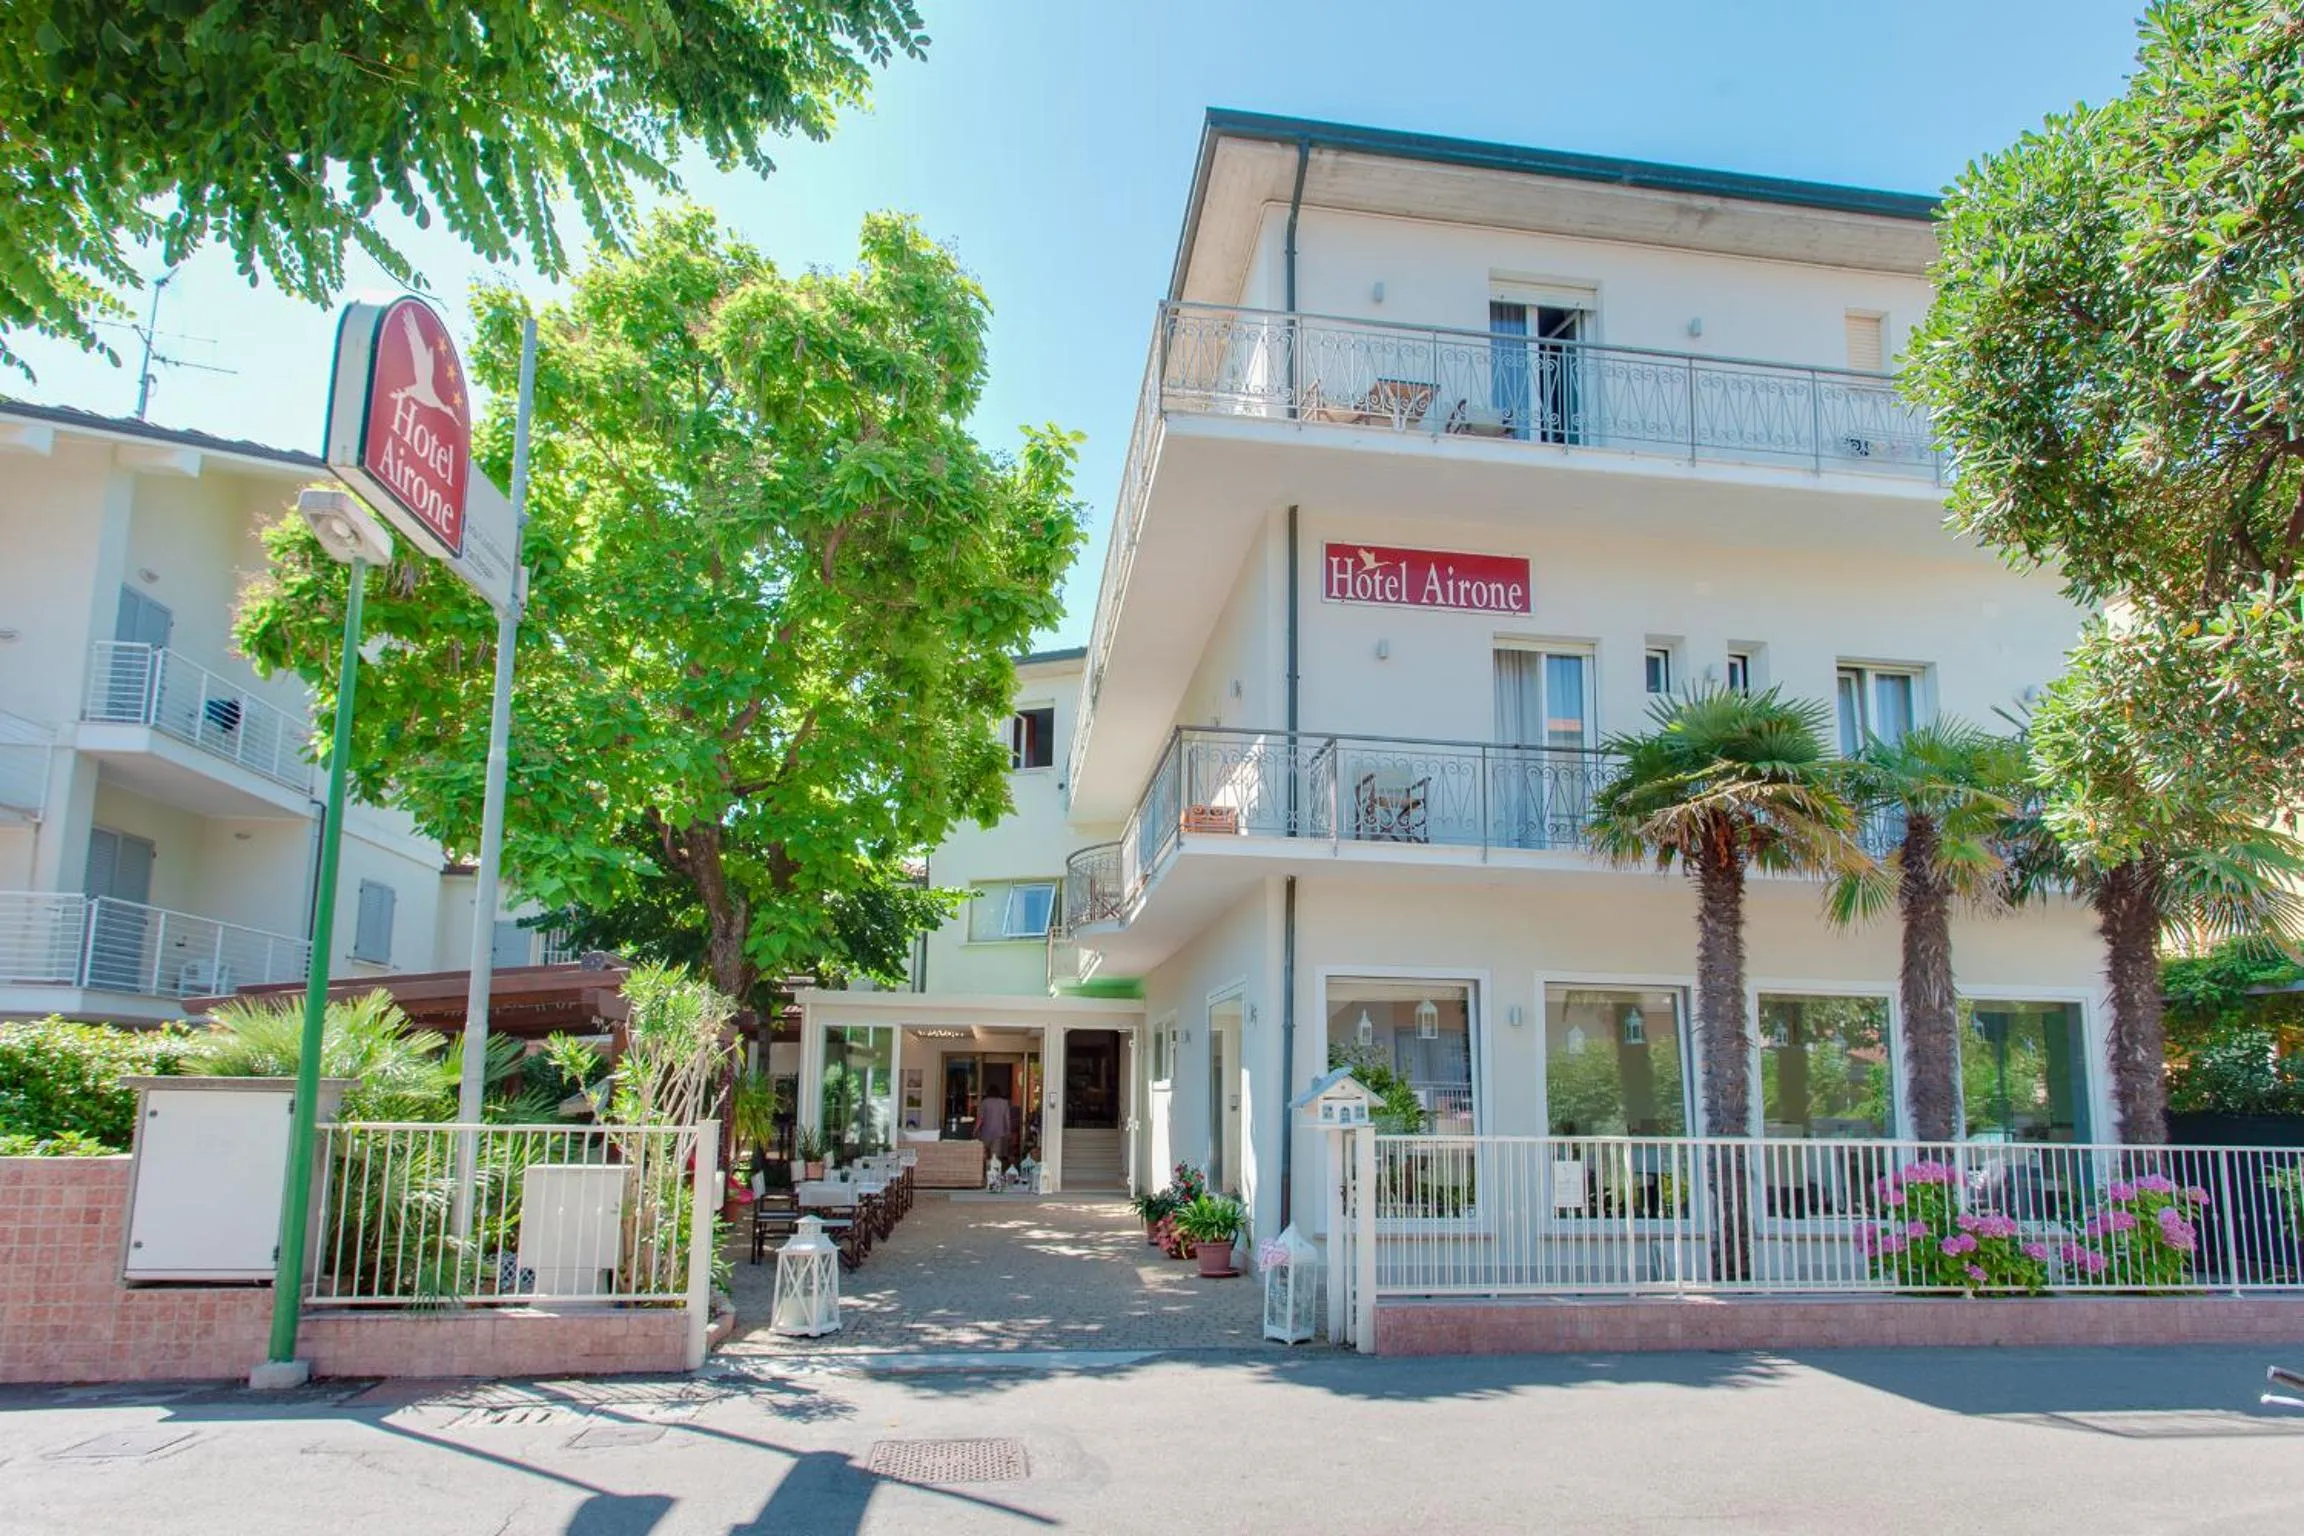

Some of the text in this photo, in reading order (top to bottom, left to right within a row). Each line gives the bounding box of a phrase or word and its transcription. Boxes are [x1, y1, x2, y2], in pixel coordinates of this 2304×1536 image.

[379, 436, 455, 535] Airone
[389, 397, 455, 488] Hotel
[1329, 556, 1523, 610] Hotel Airone
